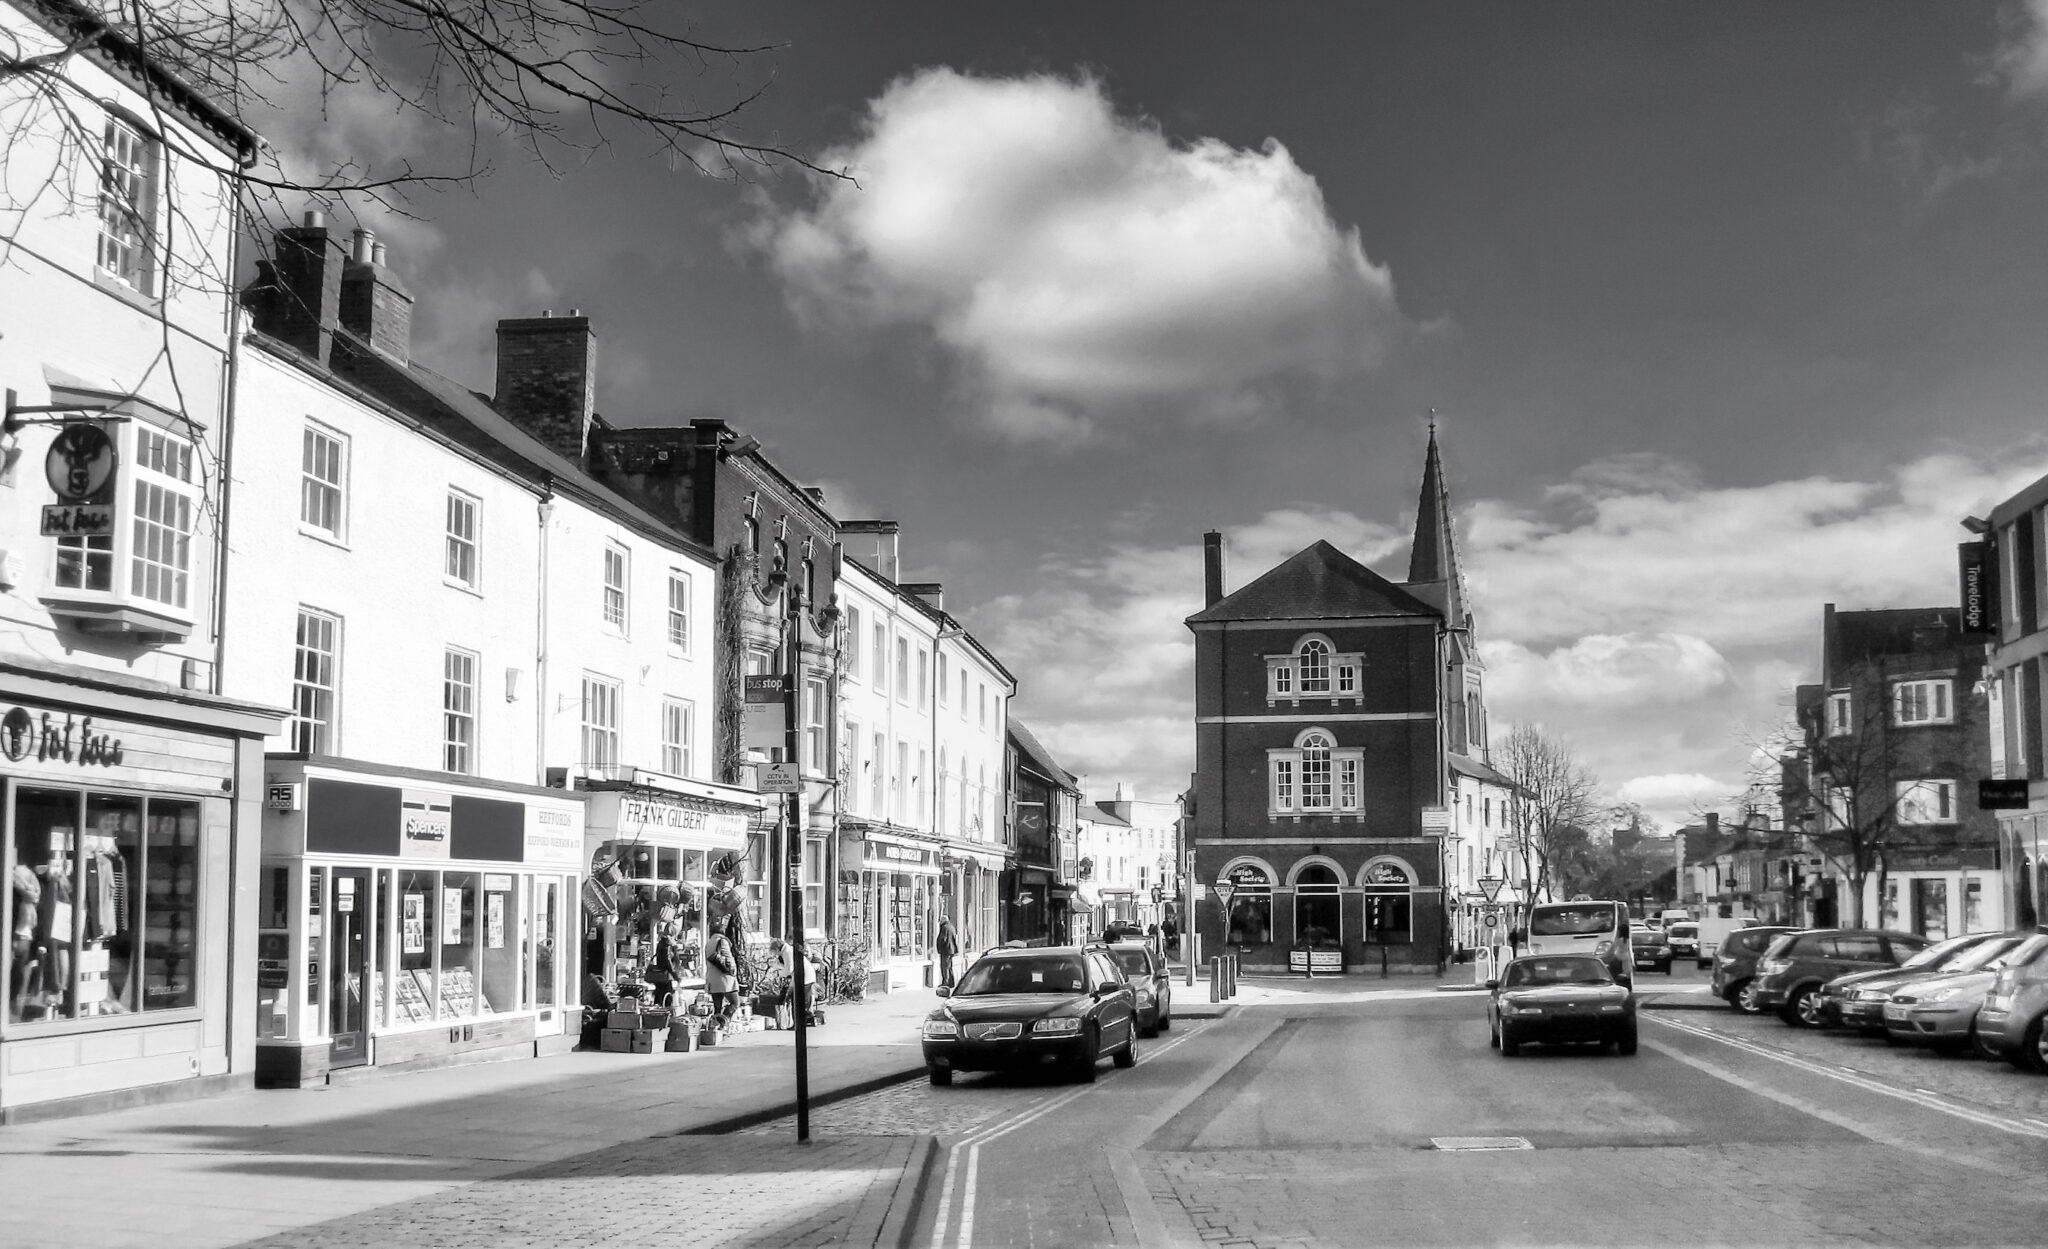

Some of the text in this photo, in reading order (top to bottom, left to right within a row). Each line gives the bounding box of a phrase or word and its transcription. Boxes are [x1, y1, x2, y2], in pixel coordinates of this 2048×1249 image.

[1967, 564, 1982, 628] Travelodge
[747, 677, 783, 692] bus stop
[407, 816, 447, 836] Spencers
[626, 802, 667, 827] FRANK
[667, 808, 710, 832] GILBERT
